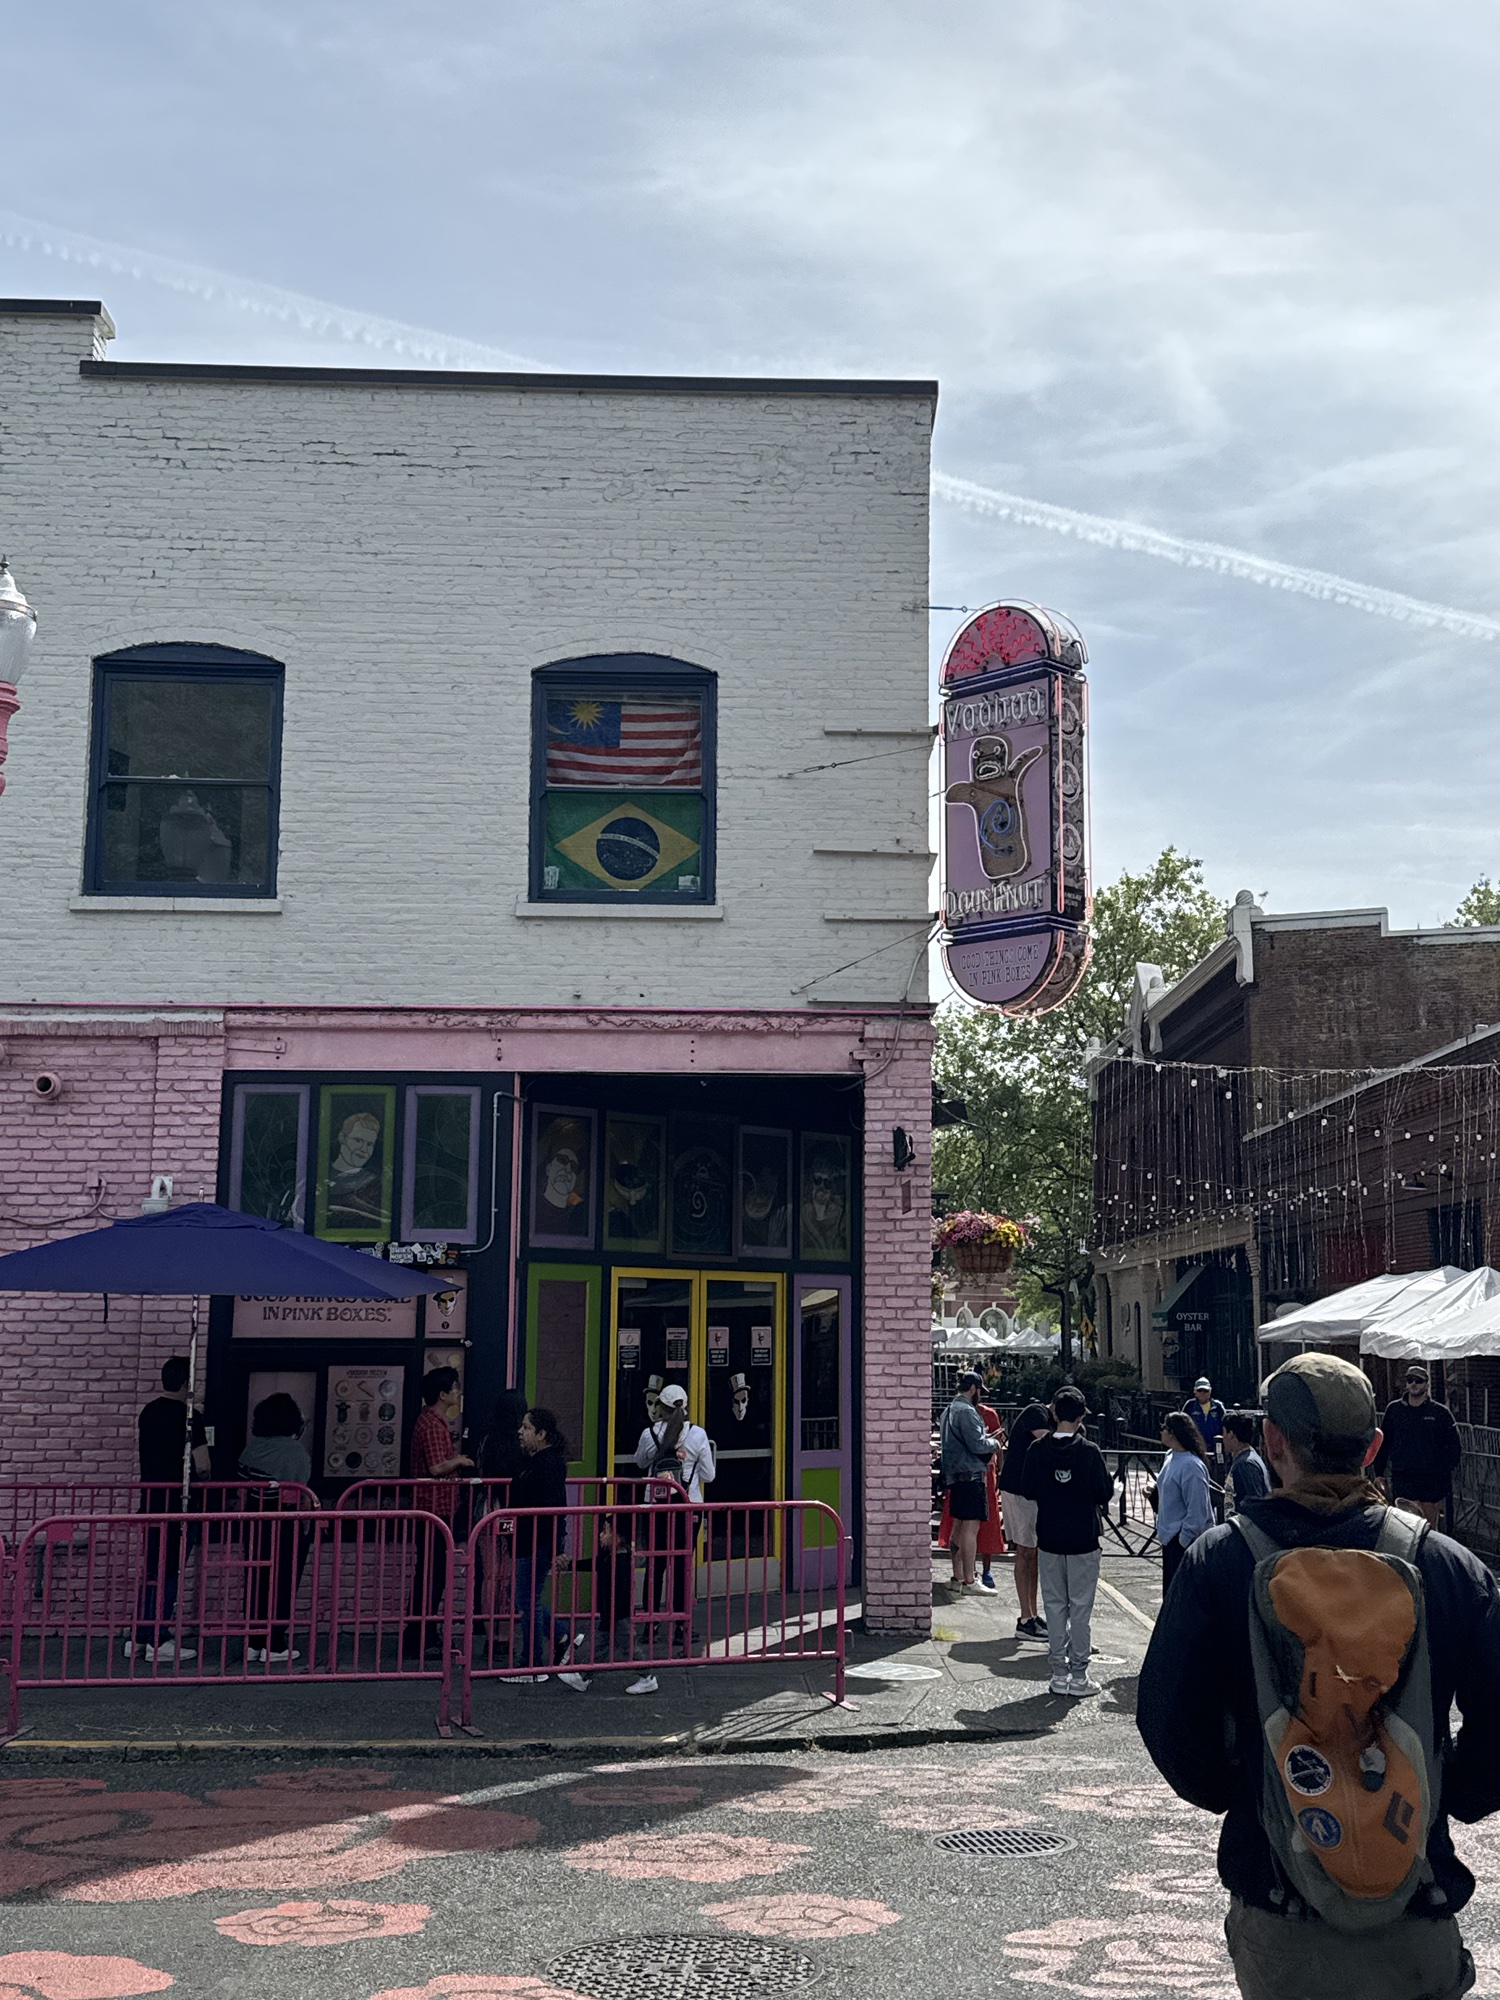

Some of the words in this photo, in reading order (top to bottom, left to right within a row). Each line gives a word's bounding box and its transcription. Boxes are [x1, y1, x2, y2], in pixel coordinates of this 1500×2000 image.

[945, 687, 1045, 738] VOODOO
[961, 952, 981, 970] GOOD
[985, 947, 1014, 967] THINGS
[1018, 944, 1039, 961] COME
[968, 972, 978, 987] IN
[982, 968, 1002, 986] PINK
[1005, 964, 1031, 982] BOXES
[263, 1306, 280, 1320] IN
[282, 1307, 324, 1321] PINK
[1176, 1312, 1210, 1321] OYSTER
[1184, 1323, 1203, 1332] BAR
